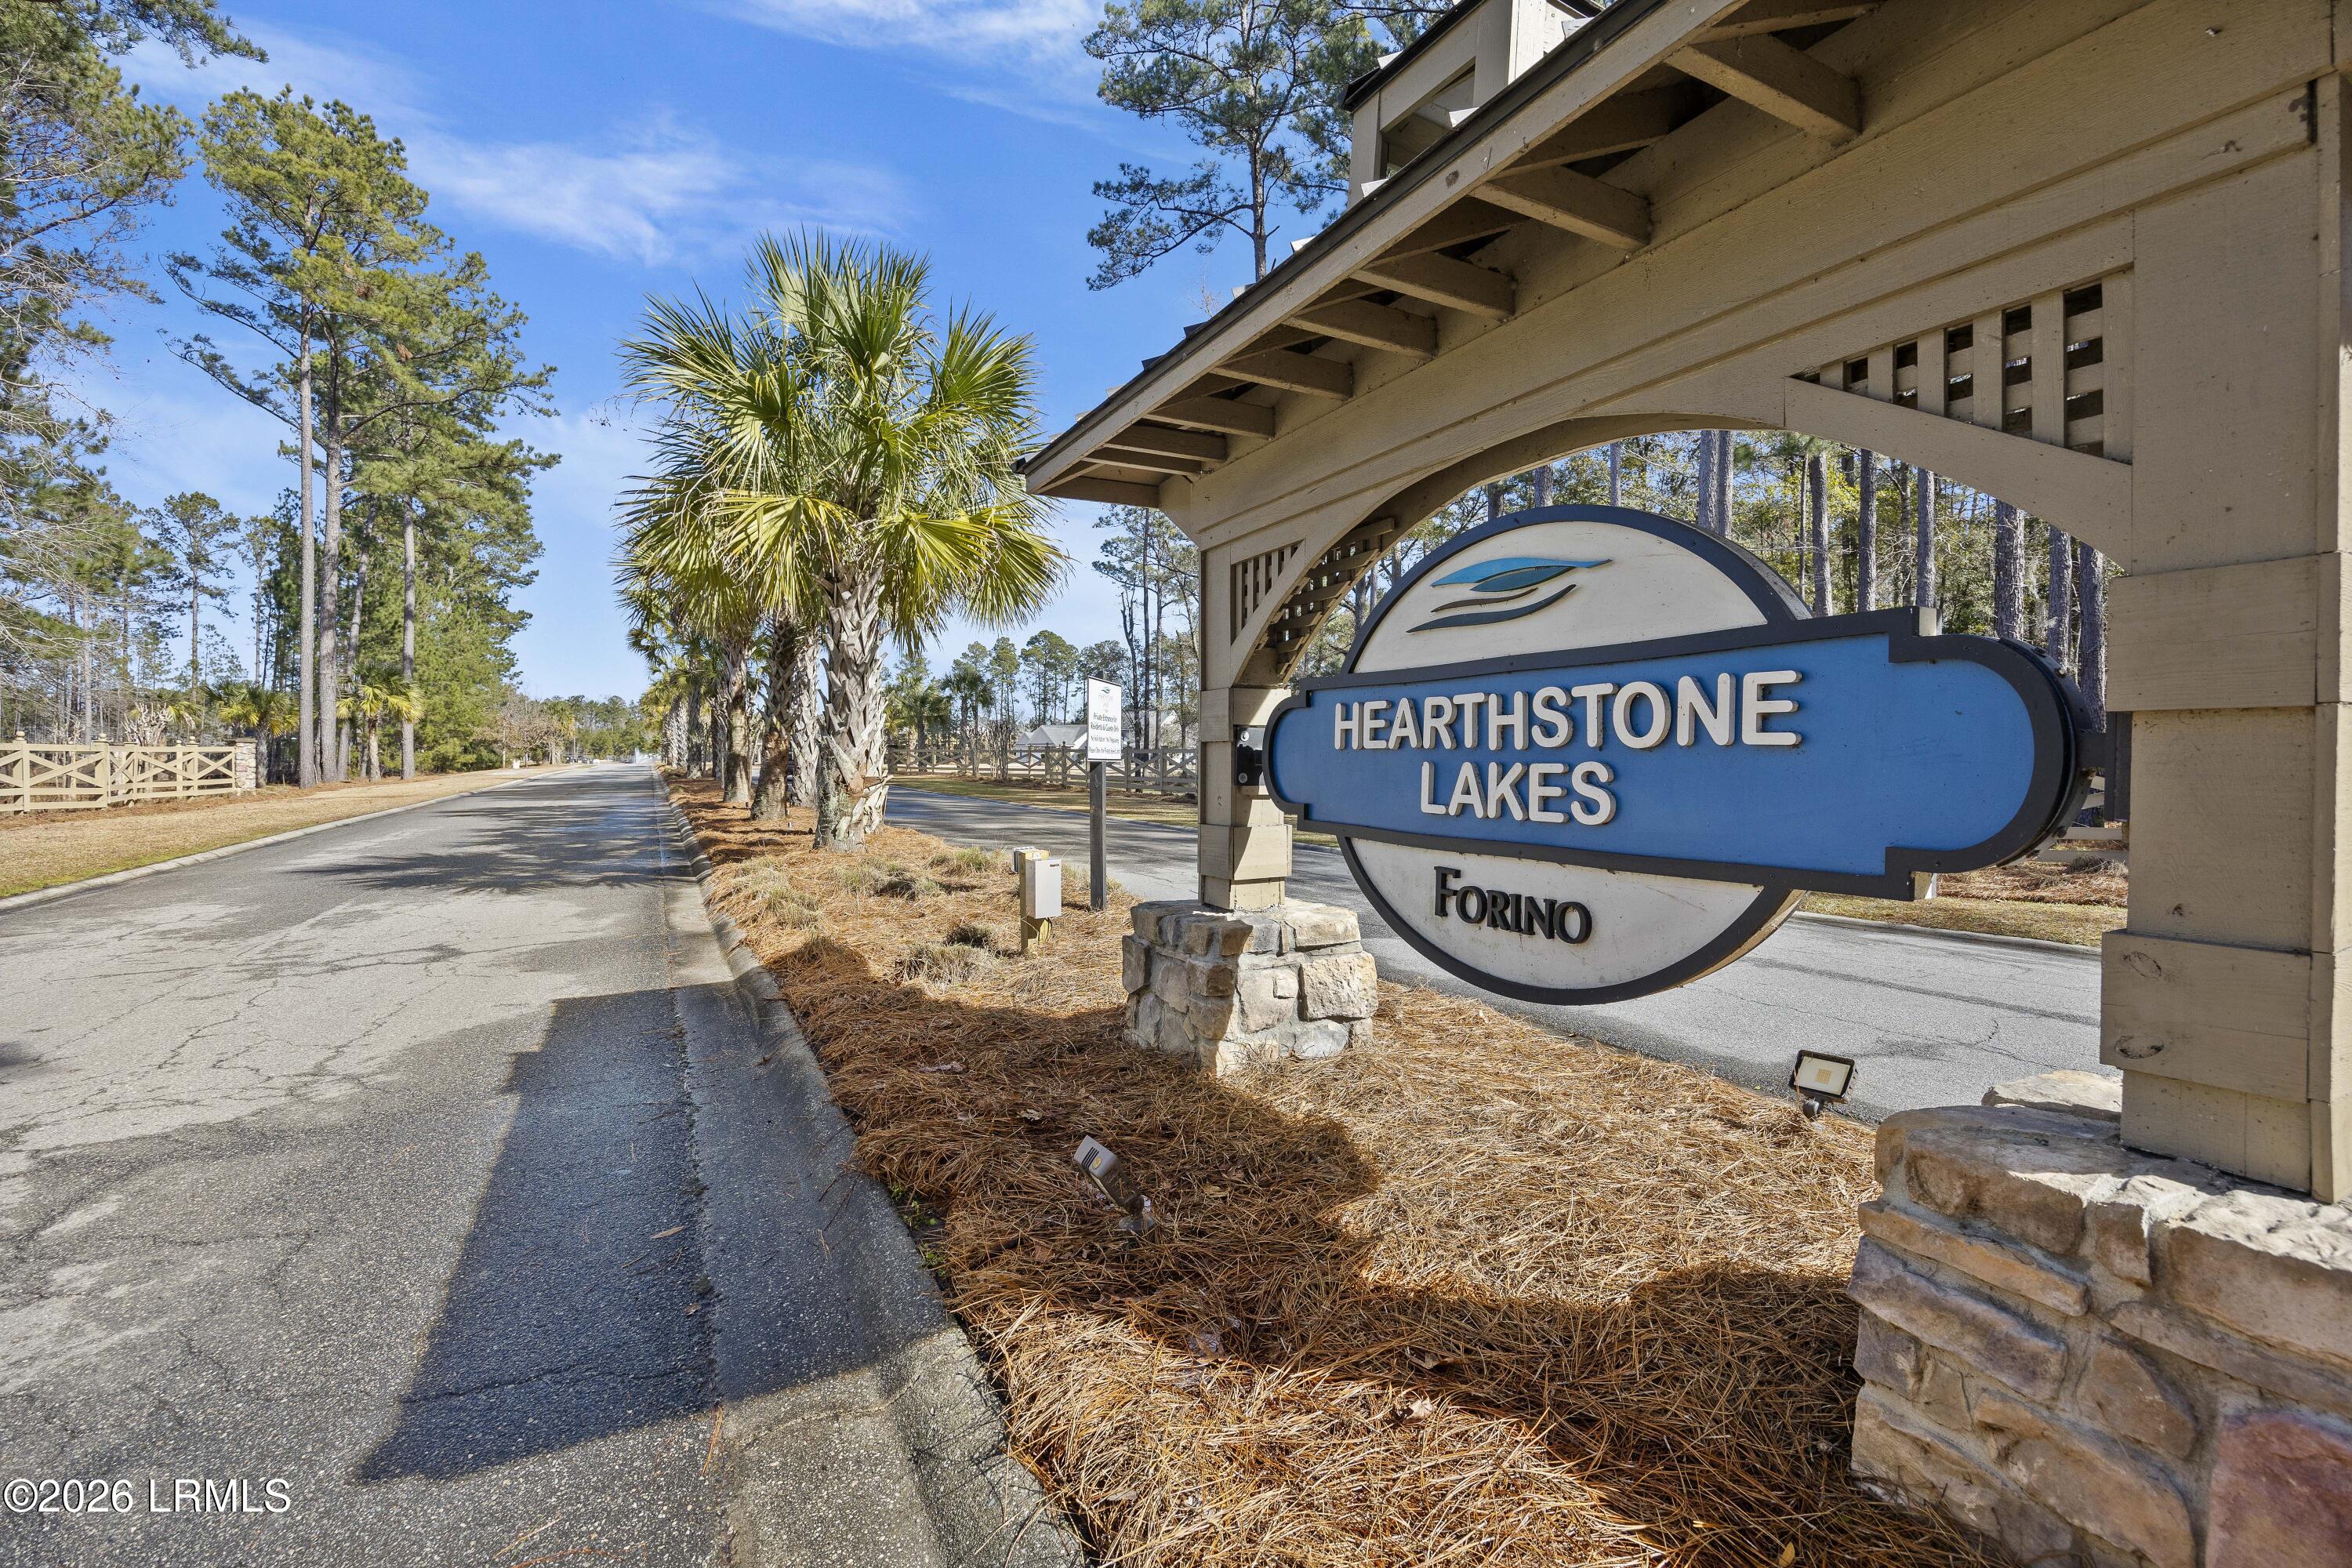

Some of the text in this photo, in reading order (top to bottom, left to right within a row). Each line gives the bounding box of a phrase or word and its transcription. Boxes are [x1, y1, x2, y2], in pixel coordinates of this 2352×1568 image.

[1334, 670, 1803, 751] HEARTHSTONE
[1421, 760, 1617, 826] LAKES
[1434, 866, 1592, 944] FORINO
